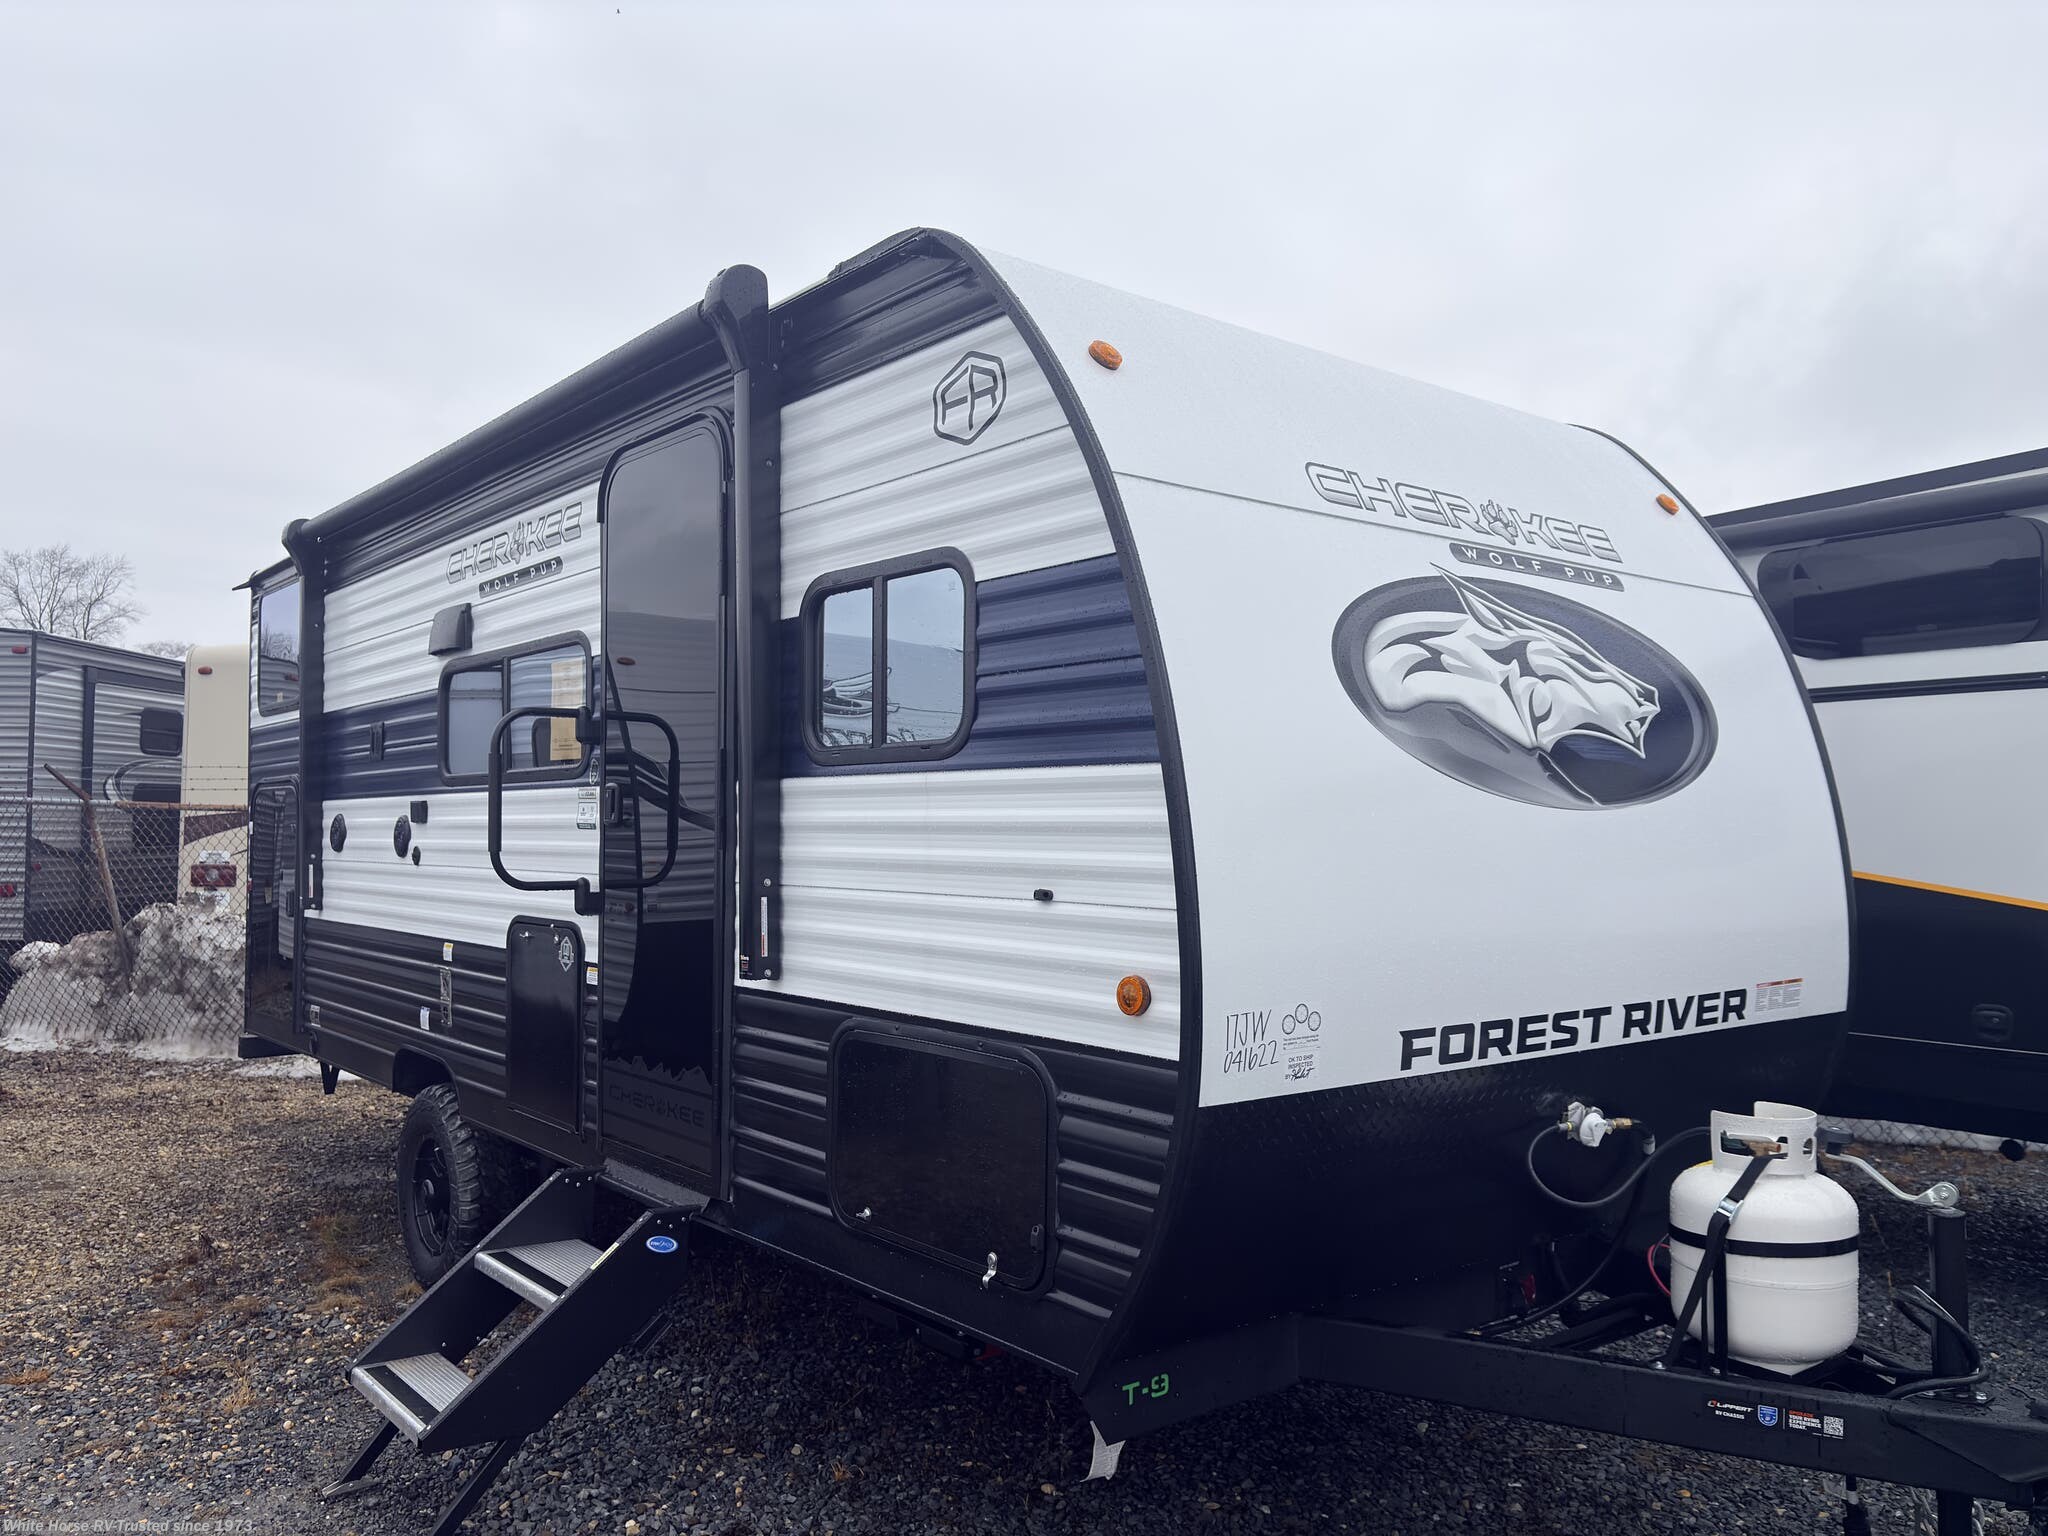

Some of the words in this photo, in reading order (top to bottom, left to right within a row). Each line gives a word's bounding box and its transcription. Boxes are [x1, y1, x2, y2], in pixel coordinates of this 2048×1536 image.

[1305, 461, 1624, 564] CHEROKEE
[482, 572, 520, 593] WOLF
[529, 560, 558, 579] PUP
[1461, 546, 1542, 572] WOLF
[1564, 567, 1613, 586] PUP
[1399, 1005, 1613, 1072] FOREST
[1621, 987, 1748, 1040] RIVER
[1223, 1039, 1280, 1074] 041622
